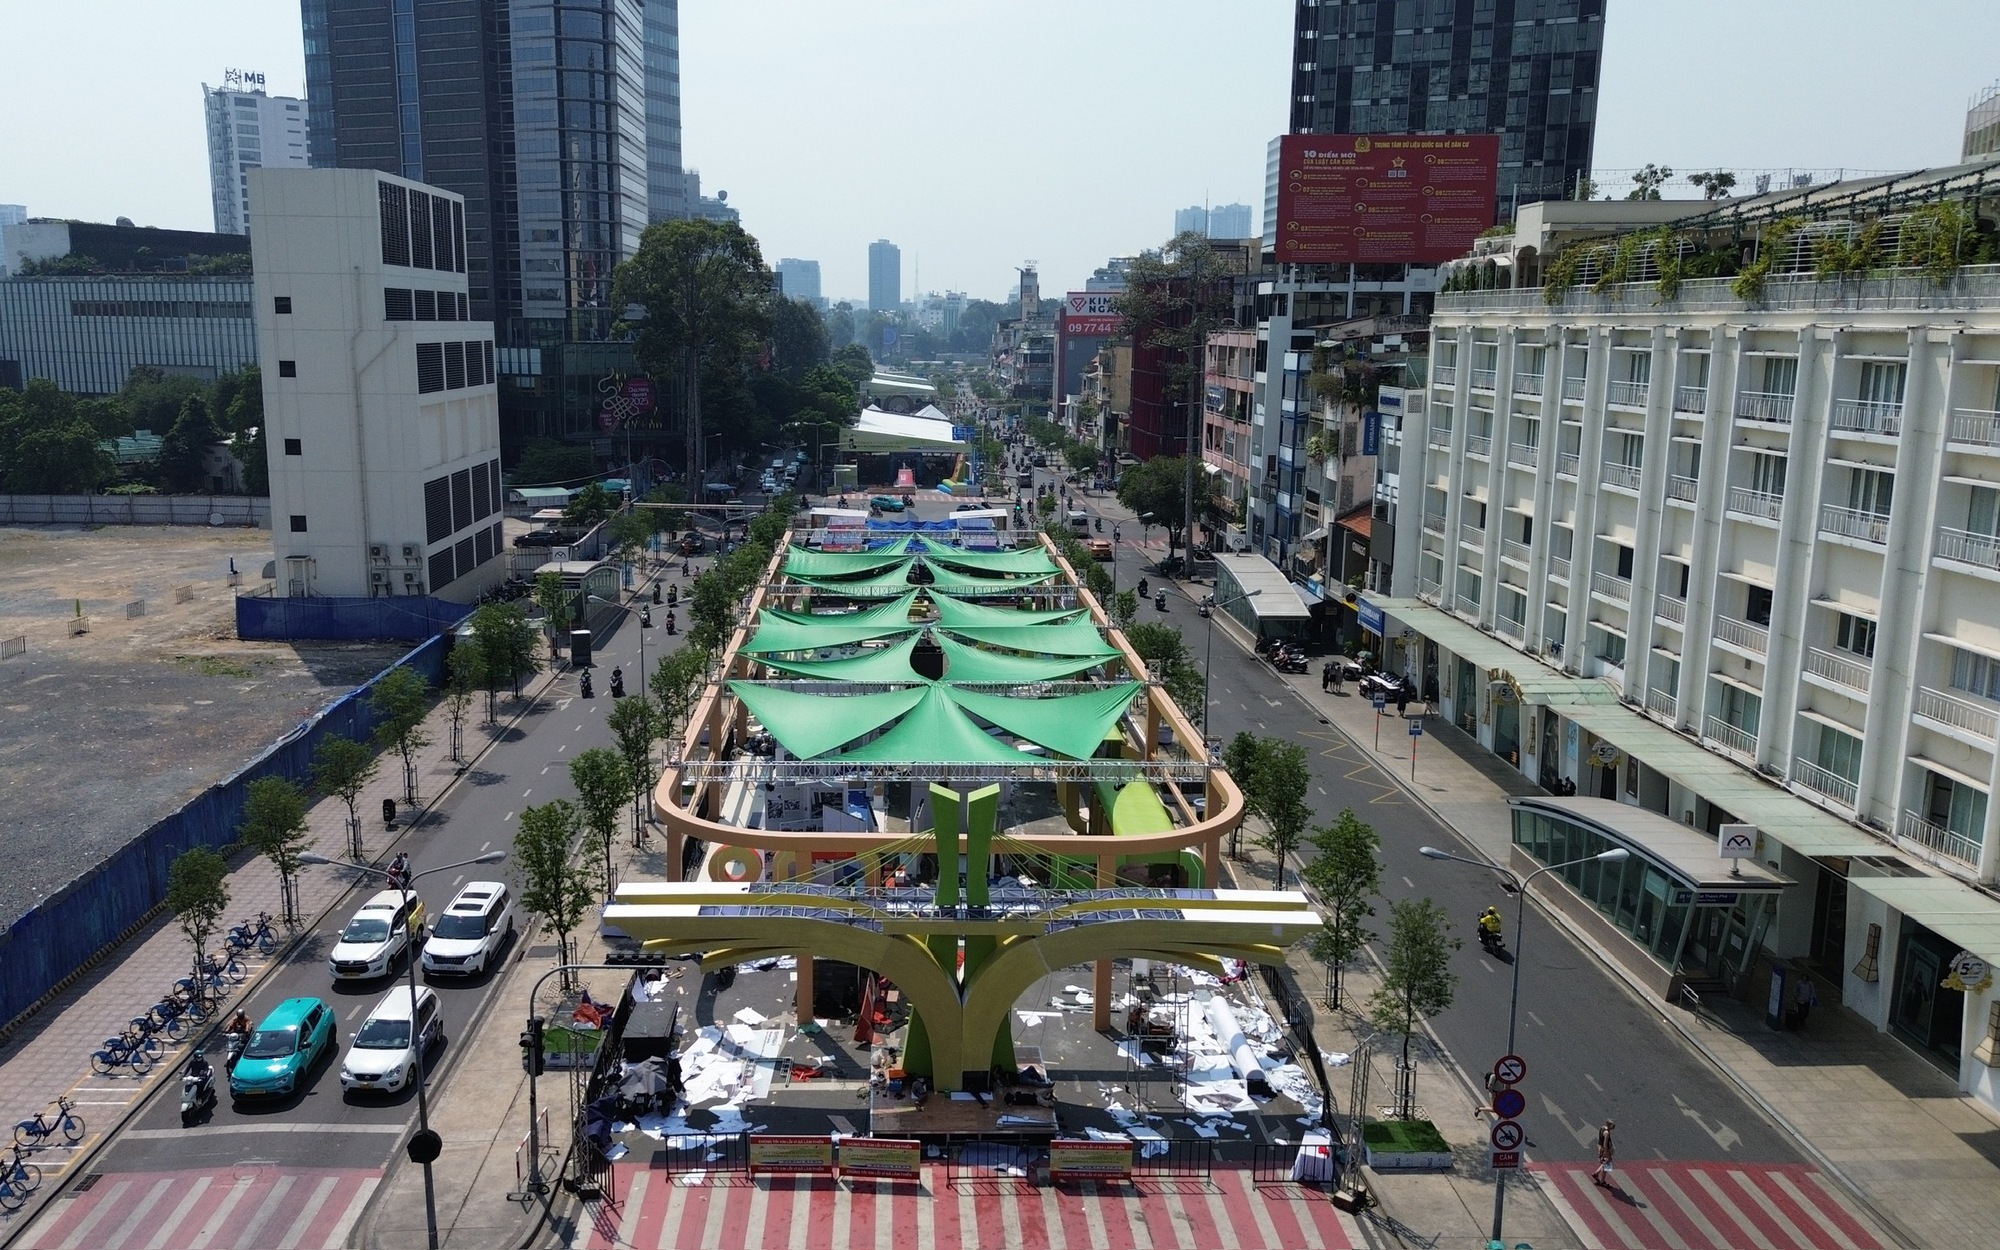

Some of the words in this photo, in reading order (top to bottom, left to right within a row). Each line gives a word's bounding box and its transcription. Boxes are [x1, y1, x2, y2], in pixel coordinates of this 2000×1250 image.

[245, 72, 265, 84] MB
[1069, 324, 1081, 332] 09
[1084, 324, 1097, 332] 77
[1098, 324, 1111, 332] 44
